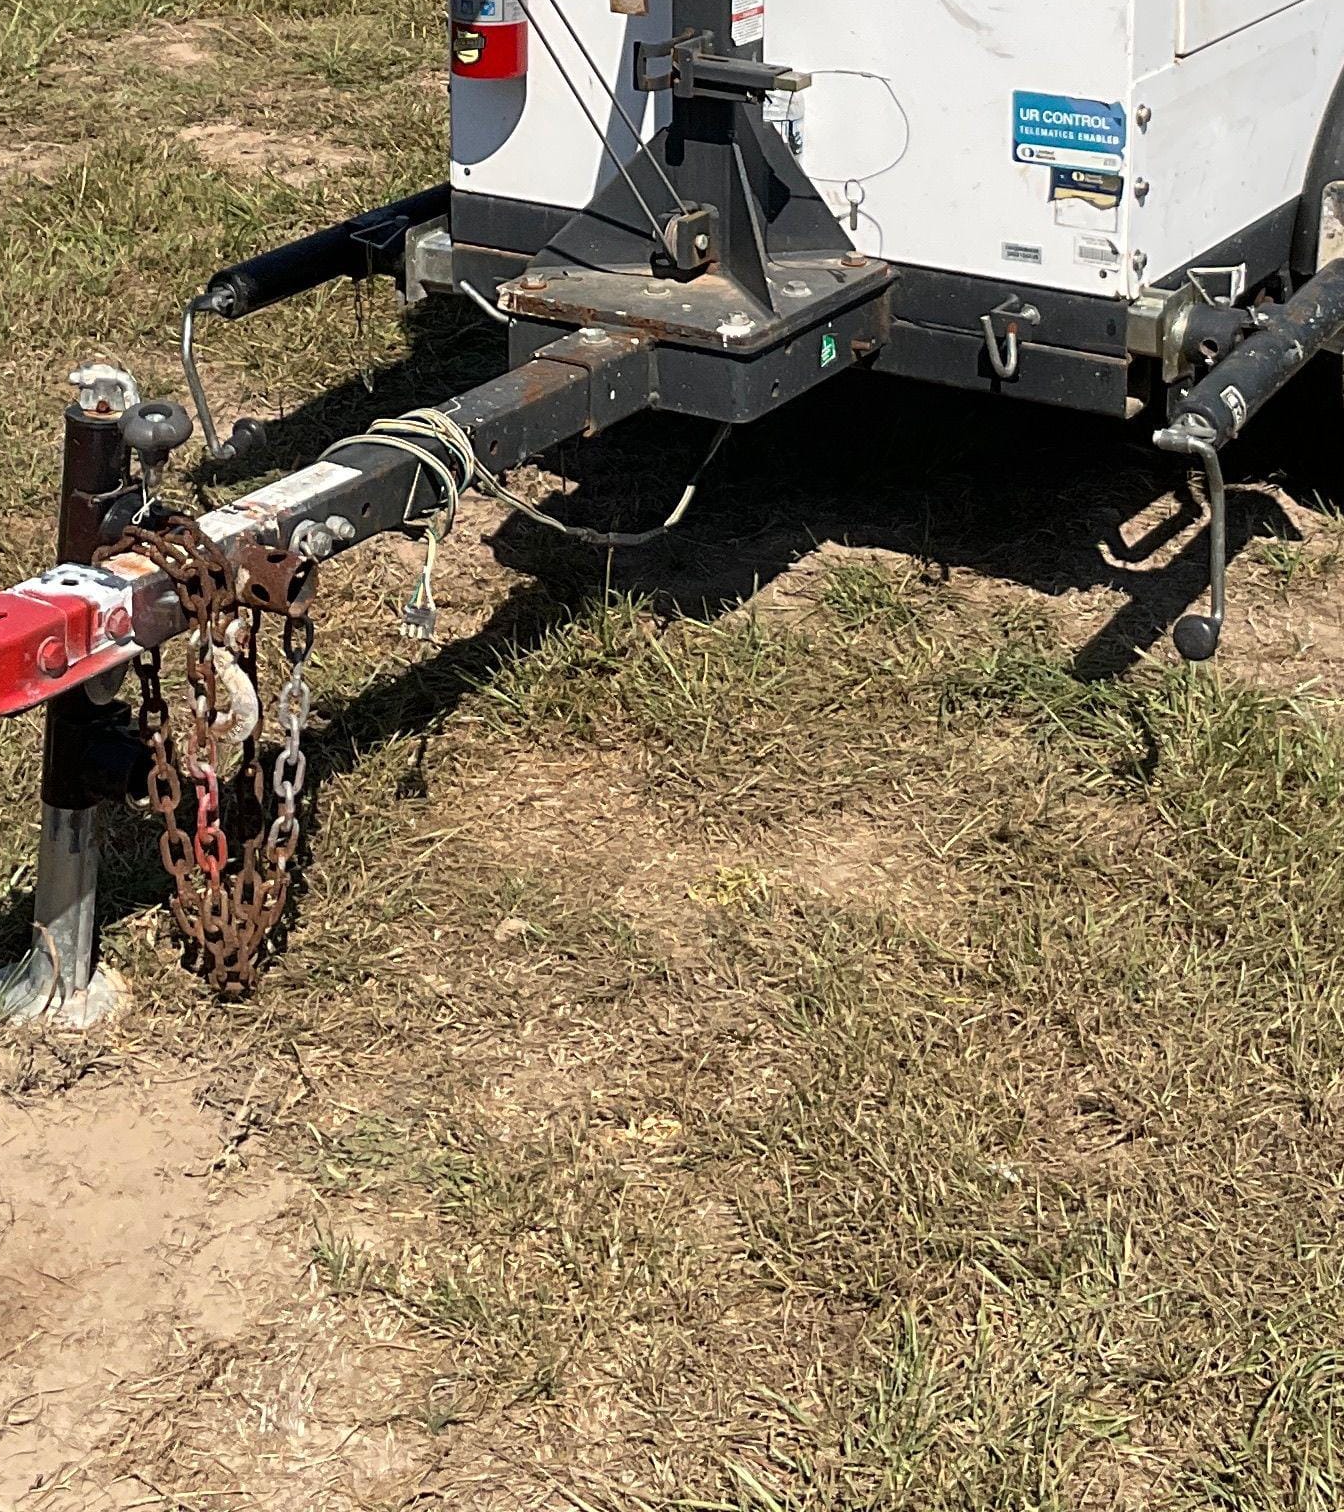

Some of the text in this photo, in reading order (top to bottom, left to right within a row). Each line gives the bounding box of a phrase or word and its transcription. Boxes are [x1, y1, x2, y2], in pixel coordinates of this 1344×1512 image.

[1019, 107, 1111, 130] UR CONTROL
[1019, 125, 1120, 145] TELEMATICS ENABLED
